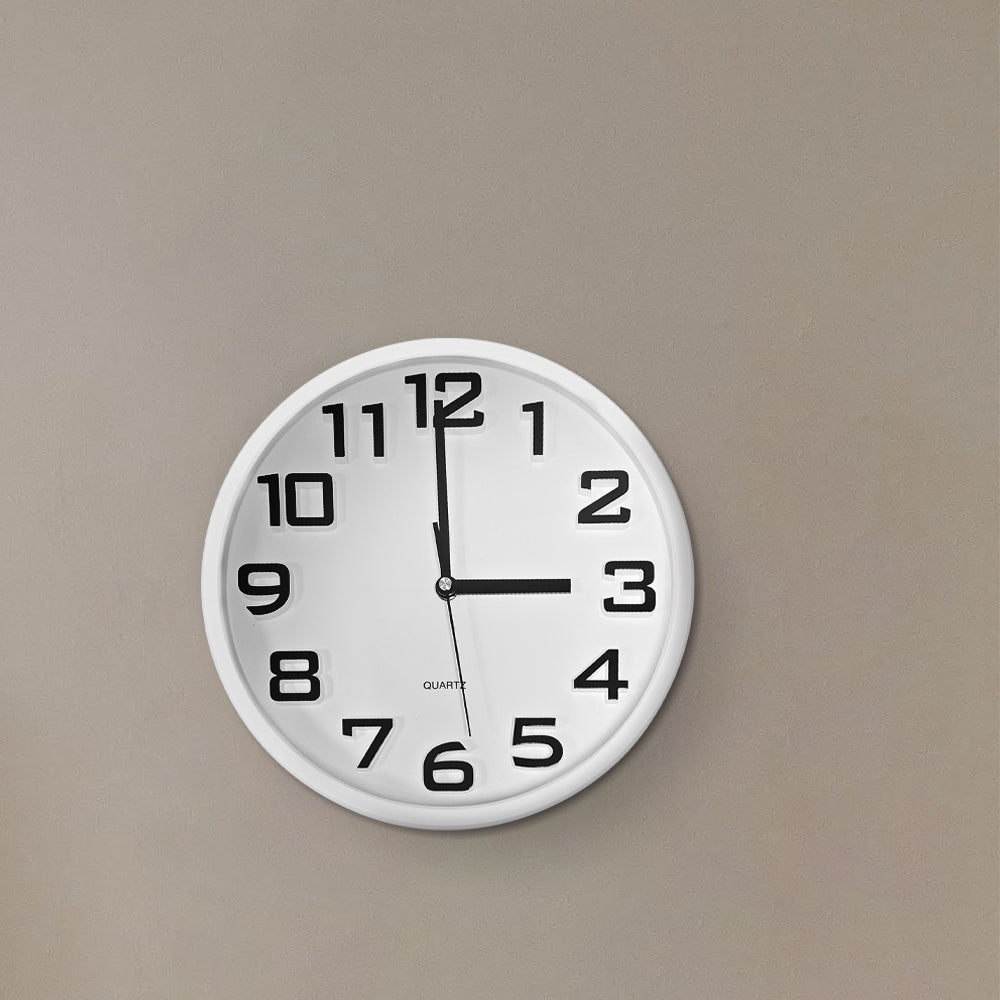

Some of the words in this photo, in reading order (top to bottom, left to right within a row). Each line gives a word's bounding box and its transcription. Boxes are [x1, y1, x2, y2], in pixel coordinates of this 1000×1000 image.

[404, 372, 485, 428] 12
[322, 402, 385, 457] 11
[522, 401, 545, 456] 1
[257, 472, 334, 527] 10
[577, 470, 631, 524] 2
[237, 562, 290, 615] 9
[603, 560, 657, 612] 3
[269, 650, 321, 702] 8
[423, 681, 467, 690] QUARTZ
[573, 648, 629, 700] 4
[342, 718, 393, 769] 7
[423, 741, 474, 792] 6
[512, 717, 563, 768] 5
